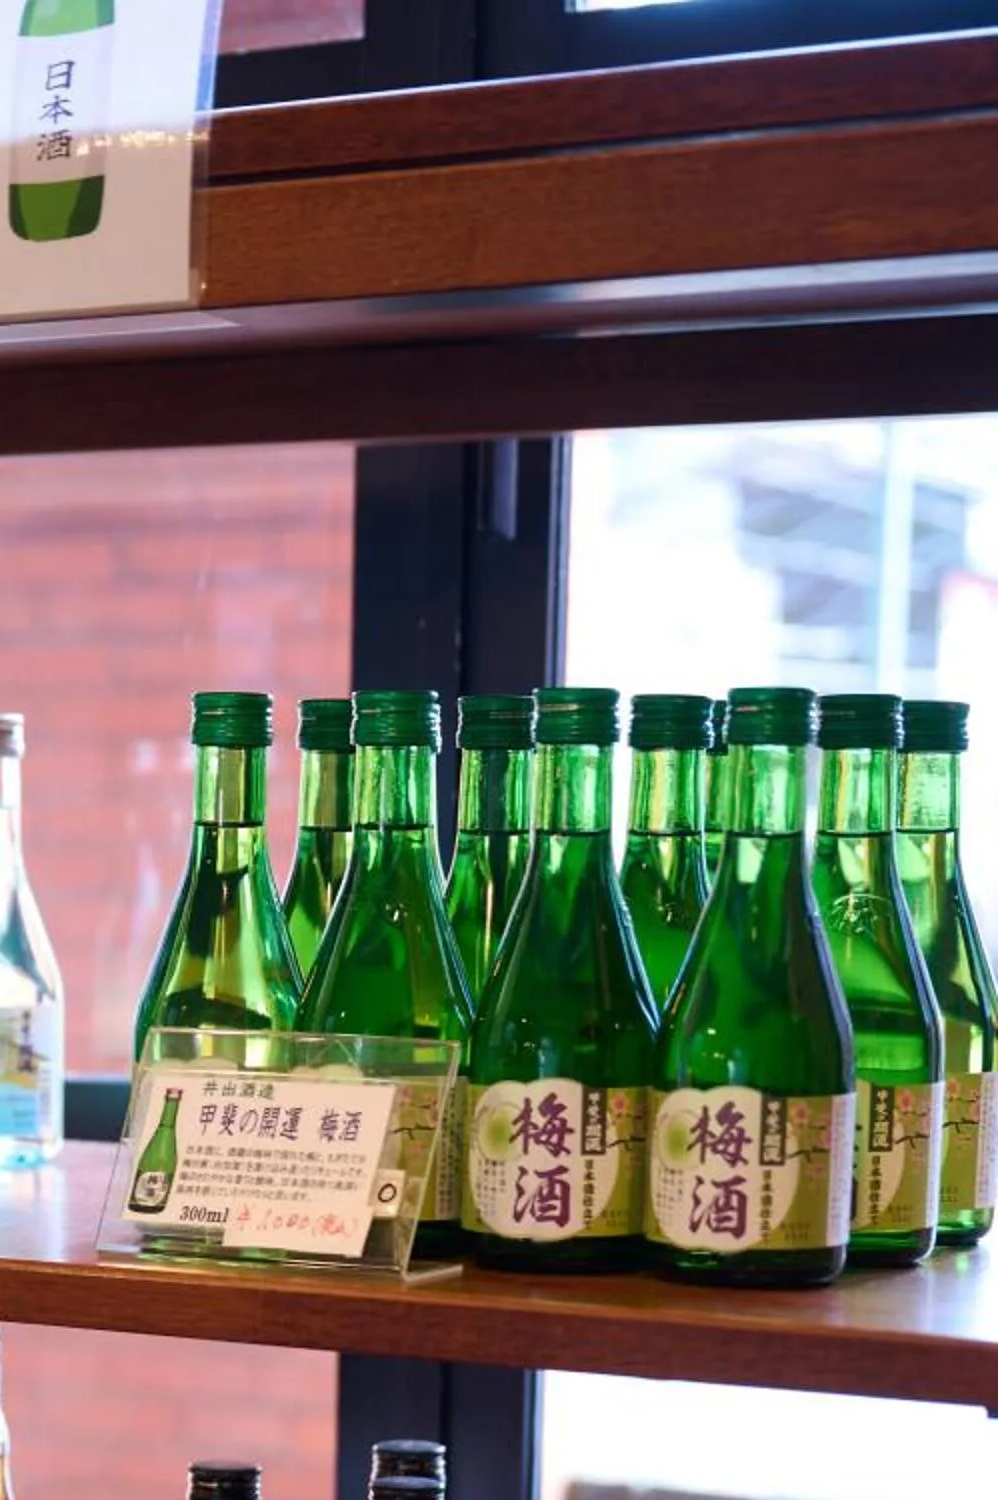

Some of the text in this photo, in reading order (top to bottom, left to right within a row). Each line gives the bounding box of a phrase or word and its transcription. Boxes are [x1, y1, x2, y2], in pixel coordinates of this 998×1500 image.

[36, 60, 75, 162] 日本酒
[199, 1103, 363, 1143] 甲斐の開運 梅酒
[509, 1092, 575, 1229] 梅酒
[686, 1101, 753, 1240] 梅酒
[179, 1205, 231, 1225] 300ml
